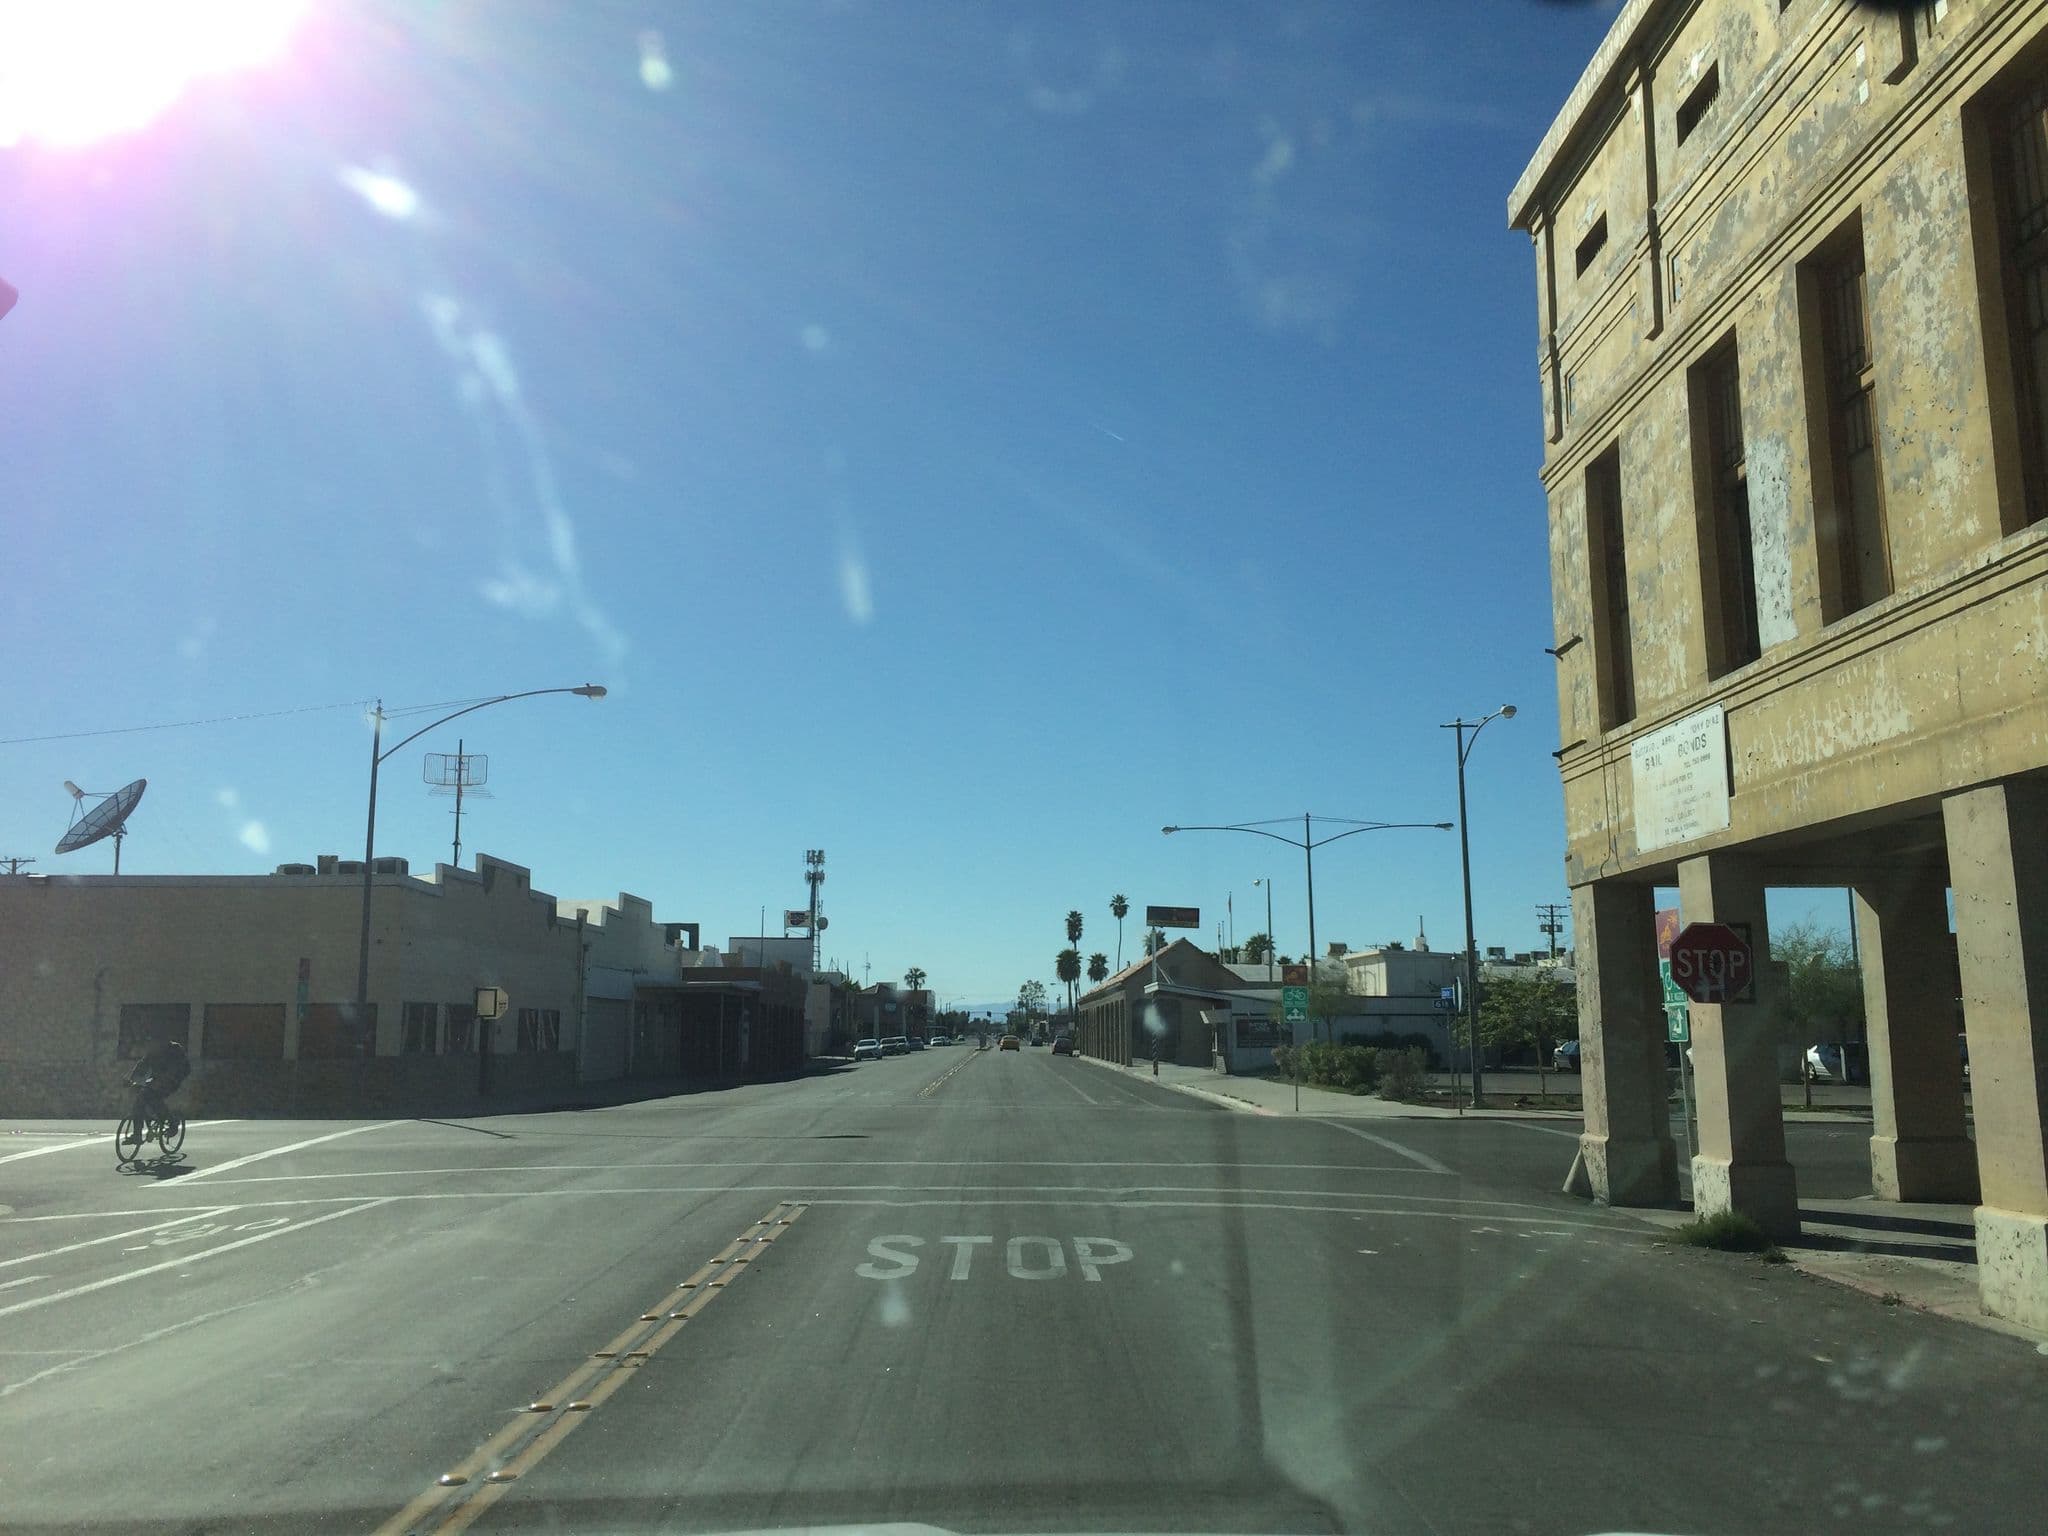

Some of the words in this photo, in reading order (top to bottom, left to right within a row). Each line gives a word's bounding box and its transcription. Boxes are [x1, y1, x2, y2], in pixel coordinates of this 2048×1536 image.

[1645, 753, 1662, 771] BAIL
[1677, 733, 1707, 758] BONDS
[1677, 949, 1745, 979] STOP
[854, 1234, 1134, 1282] STOP
